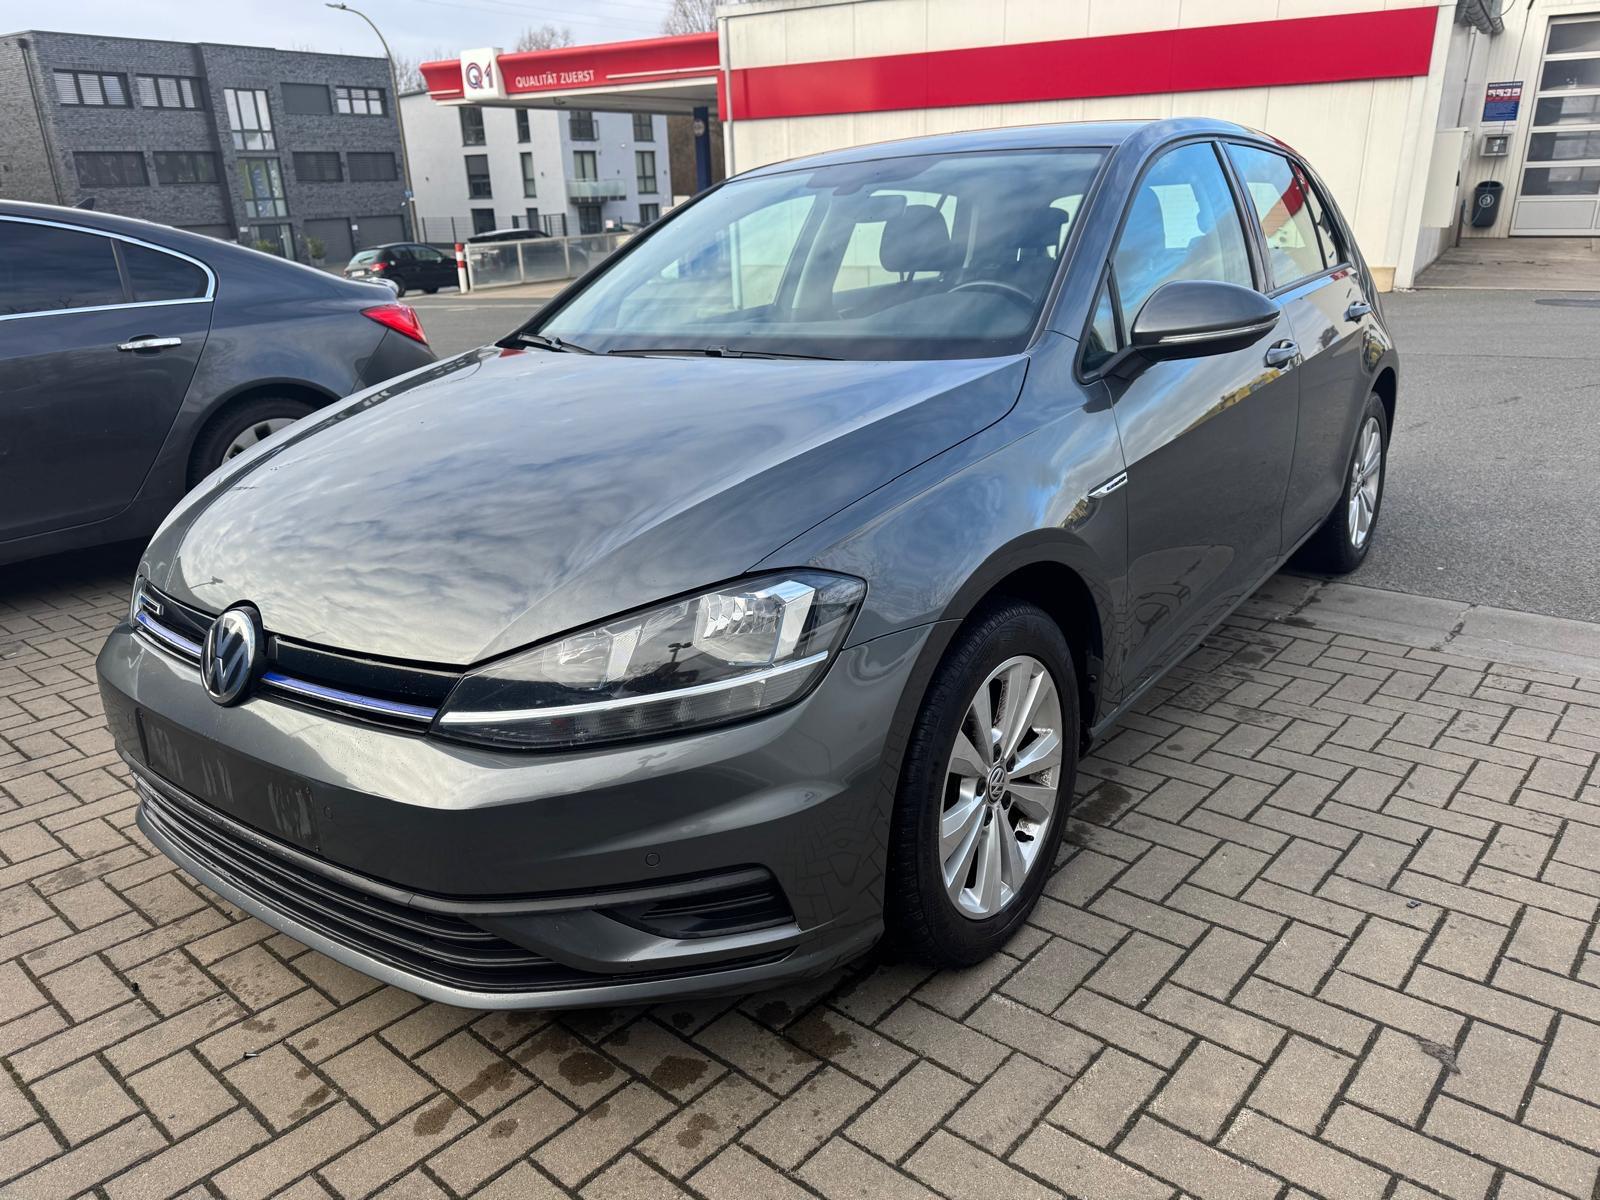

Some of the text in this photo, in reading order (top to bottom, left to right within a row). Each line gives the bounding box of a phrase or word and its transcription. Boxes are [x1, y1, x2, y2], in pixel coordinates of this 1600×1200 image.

[466, 60, 494, 89] Q1
[515, 69, 594, 88] QUALITÄT ZUERST
